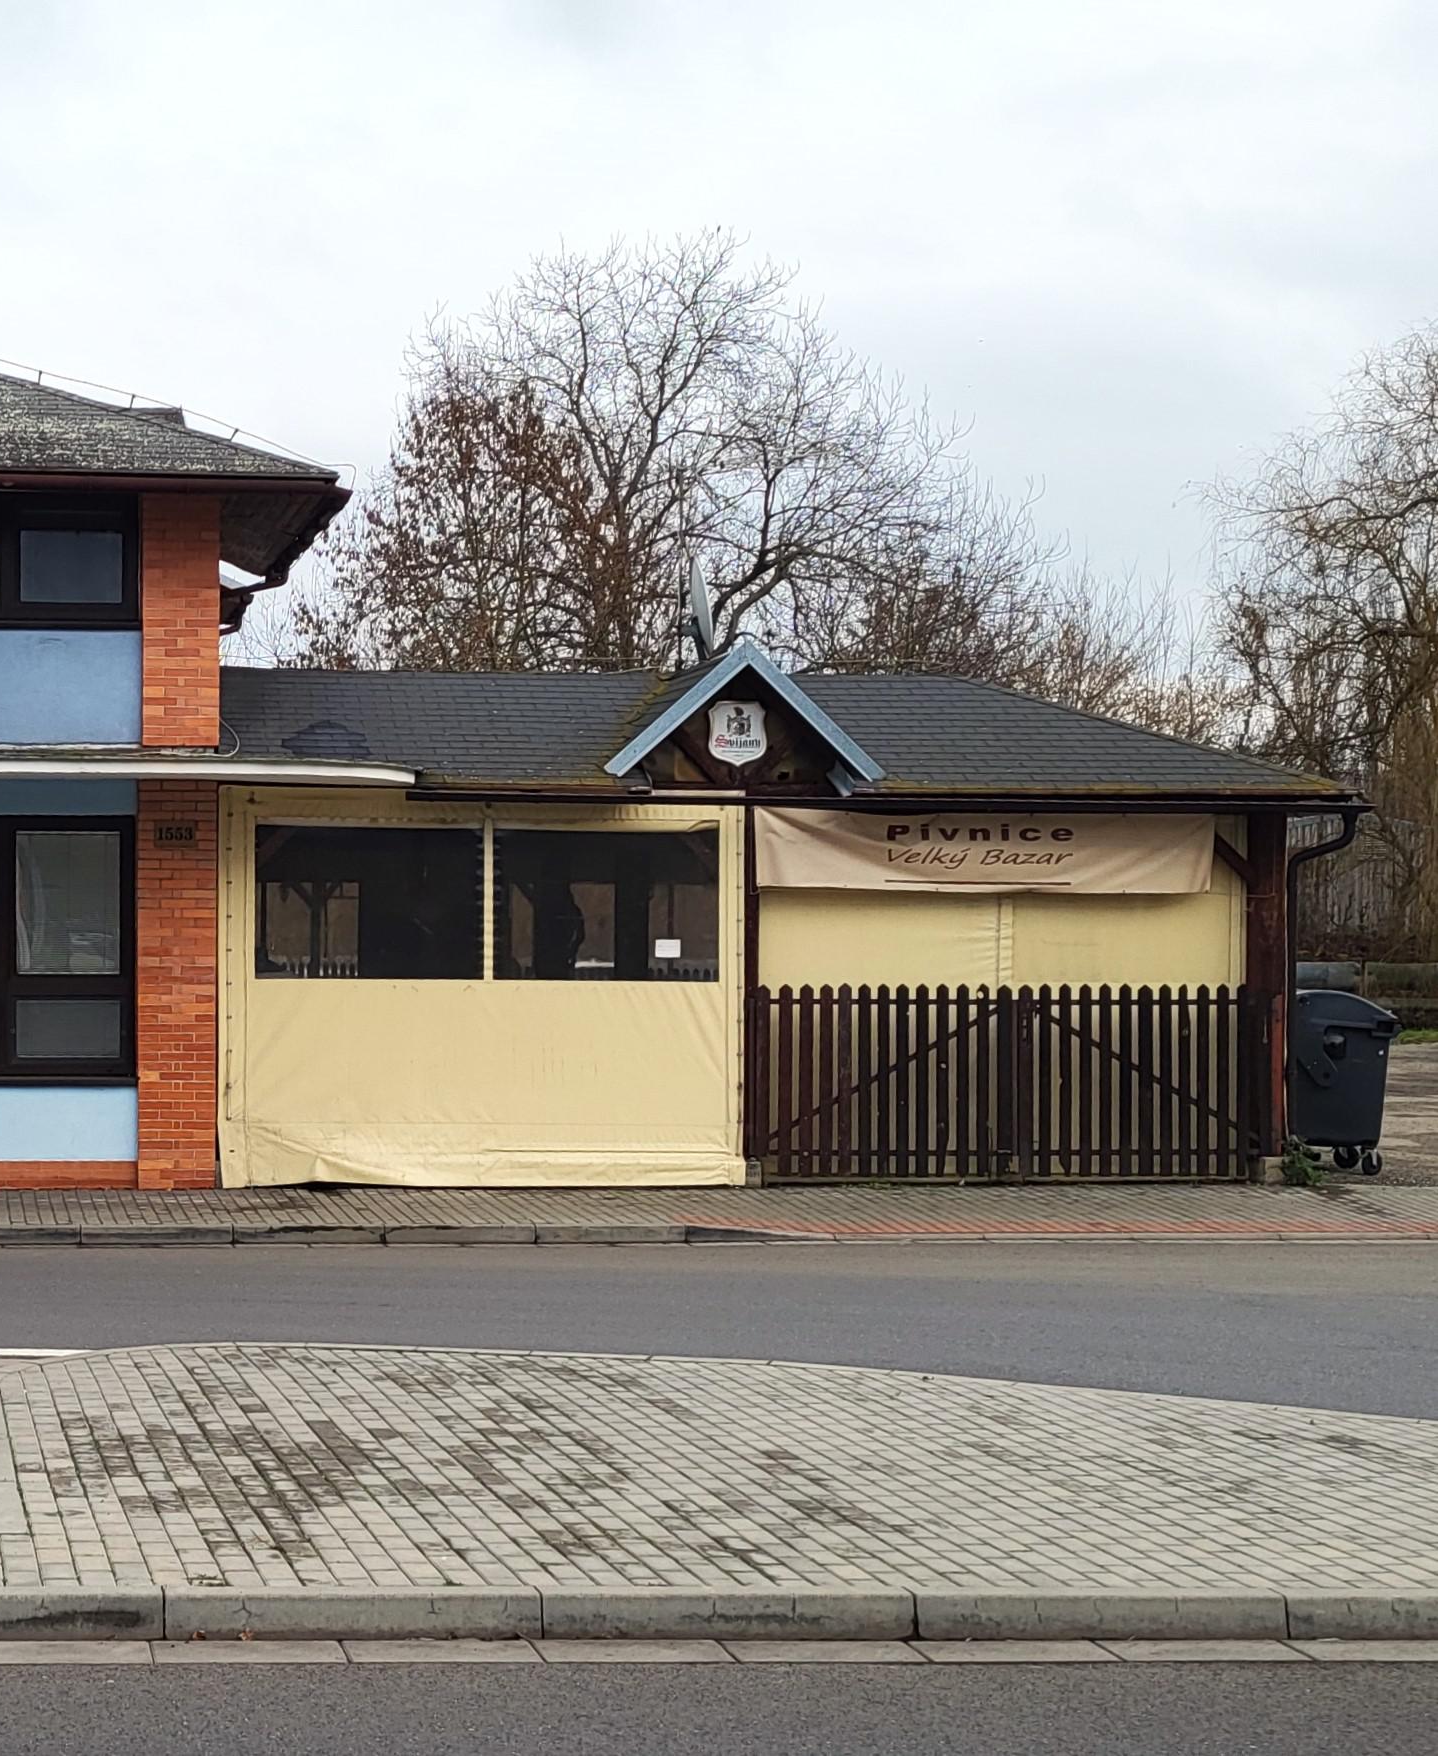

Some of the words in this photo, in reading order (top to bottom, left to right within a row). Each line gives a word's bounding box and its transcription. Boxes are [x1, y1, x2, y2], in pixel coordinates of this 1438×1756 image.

[156, 827, 193, 841] 1553
[886, 824, 1074, 841] Pivnice
[886, 847, 971, 870] Velký
[979, 849, 1073, 866] Bazar
